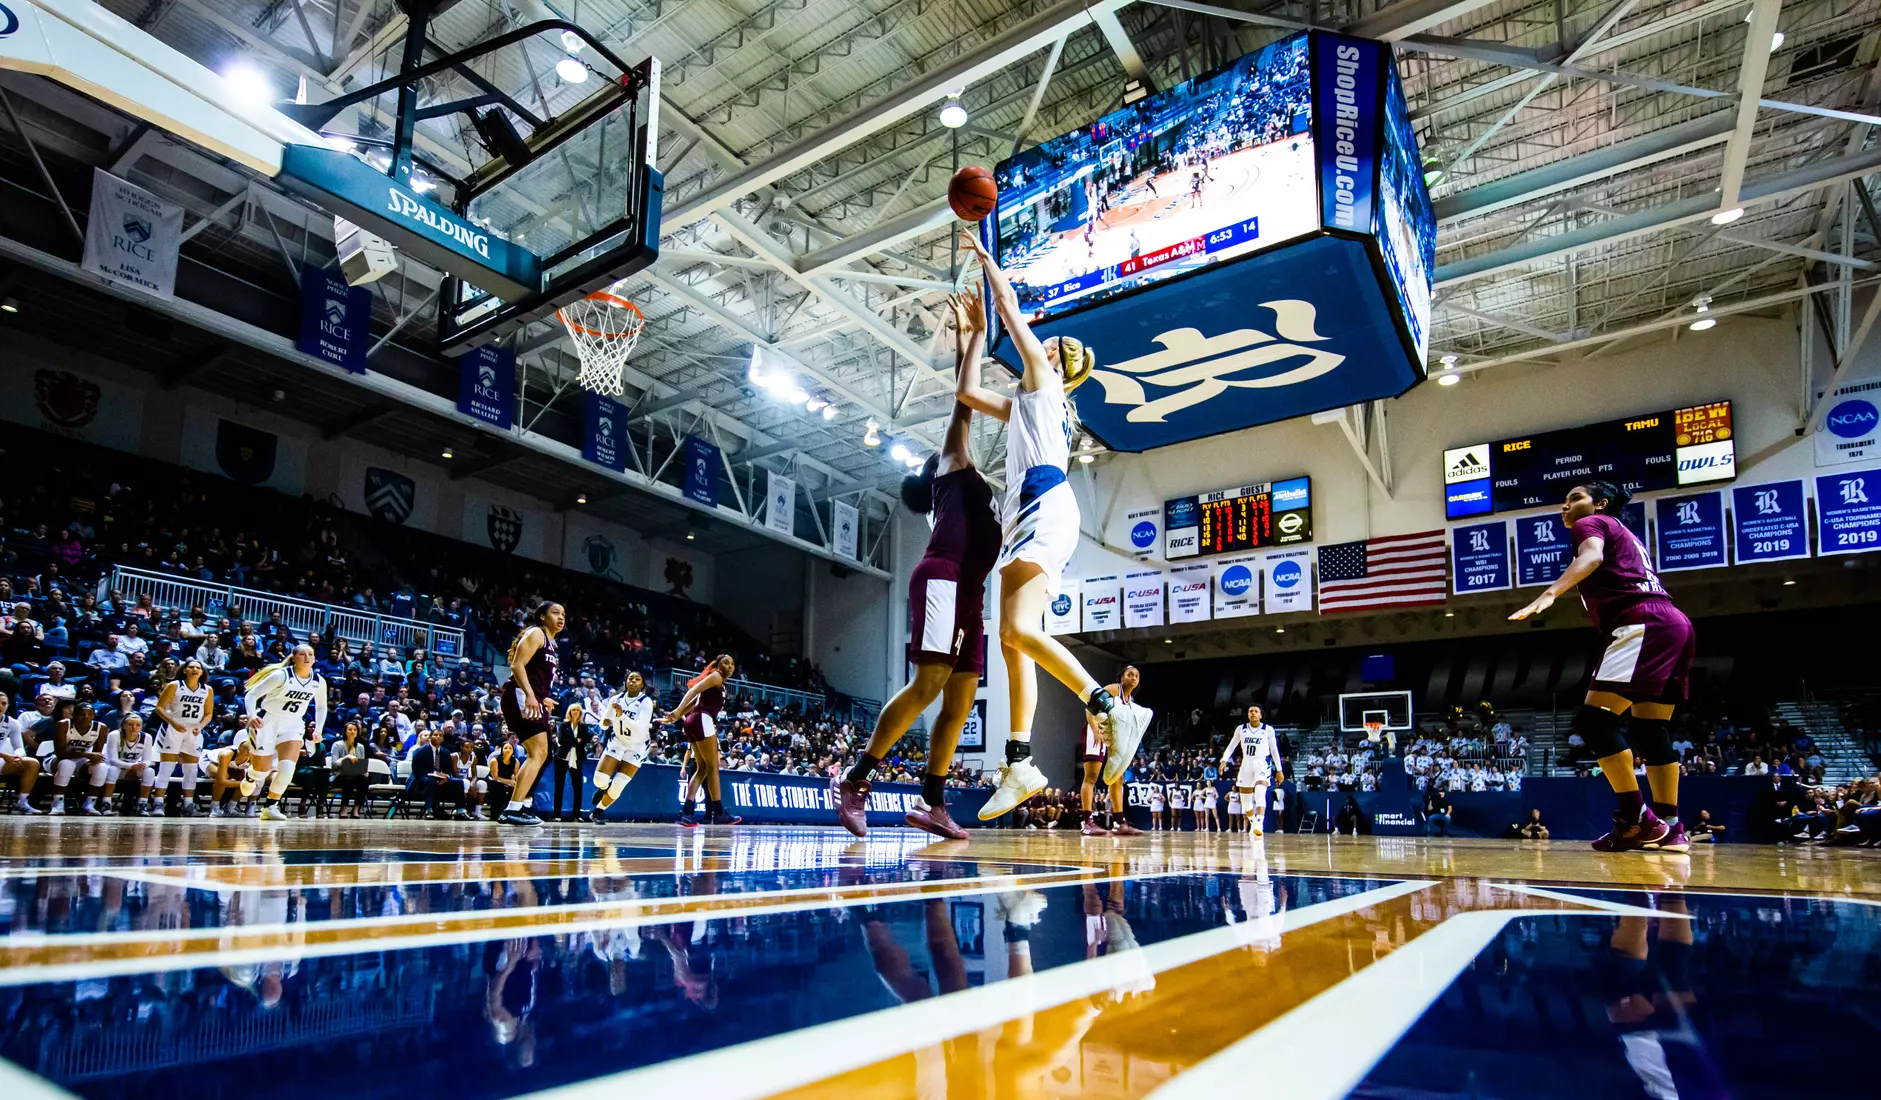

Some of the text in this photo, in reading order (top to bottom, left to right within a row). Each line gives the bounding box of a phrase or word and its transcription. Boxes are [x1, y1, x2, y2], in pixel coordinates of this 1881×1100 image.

[1334, 45, 1360, 227] ShopRiceU.com
[388, 188, 490, 260] SPALDING
[1210, 221, 1256, 244] 6:53 14
[113, 235, 156, 262] RICE
[1124, 261, 1136, 273] 41
[1142, 252, 1169, 267] Texas
[120, 263, 141, 276] LISA
[100, 264, 160, 291] McCORMICK
[1048, 281, 1081, 298] 37 Rice
[320, 319, 351, 341] RICE
[320, 339, 347, 355] ROBERT
[322, 348, 342, 361] CURL
[474, 384, 501, 401] RICE
[471, 400, 501, 415] RICHARD
[471, 406, 498, 421] SMALLEY
[1624, 418, 1659, 431] TAMU
[1683, 419, 1724, 432] LOCAL
[1831, 411, 1877, 427] NCAA
[595, 433, 615, 448] RICE
[1692, 429, 1713, 444] 716
[1503, 440, 1532, 452] RICE
[1555, 455, 1582, 465] PERIOD
[1645, 455, 1672, 465] FOULS
[1678, 453, 1735, 471] OWLS
[1448, 466, 1488, 478] adidas
[1543, 464, 1613, 480] PLAYER FOUL PTS
[1495, 479, 1518, 488] FOULS
[1622, 482, 1643, 490] T.O.L.
[1208, 492, 1225, 501] RICE
[1240, 485, 1265, 496] GUEST
[1257, 493, 1267, 501] PTS
[1839, 478, 1869, 505] R
[1754, 489, 1783, 516] R
[1676, 500, 1702, 526] R
[1742, 525, 1779, 534] UNDEFEATED
[1833, 519, 1880, 530] CHAMPIONS
[1133, 530, 1155, 540] NCAA
[1533, 520, 1556, 543] R
[1749, 529, 1793, 539] CHAMPIONS
[1838, 530, 1878, 545] 2019
[1170, 537, 1195, 549] RICE
[1469, 529, 1491, 552] R
[1670, 539, 1712, 549] CHAMPIONS
[1753, 539, 1790, 553] 2019
[1530, 551, 1562, 564] WNIT
[1464, 564, 1499, 573] CHAMPIONS
[1224, 578, 1252, 589] NCAA
[1276, 572, 1302, 582] NCAA
[1468, 573, 1496, 586] 2017
[1127, 588, 1160, 598] C-USA
[1172, 583, 1206, 593] C-USA
[1087, 596, 1116, 606] C-USA
[180, 695, 204, 704] RICE
[285, 690, 313, 701] RICE
[182, 704, 200, 719] 22
[282, 700, 303, 713] 15
[963, 721, 977, 735] 22
[68, 740, 92, 748] RICE
[1246, 745, 1256, 756] 10
[732, 782, 753, 806] THE
[754, 784, 779, 808] TRUE
[1379, 812, 1403, 820] smart
